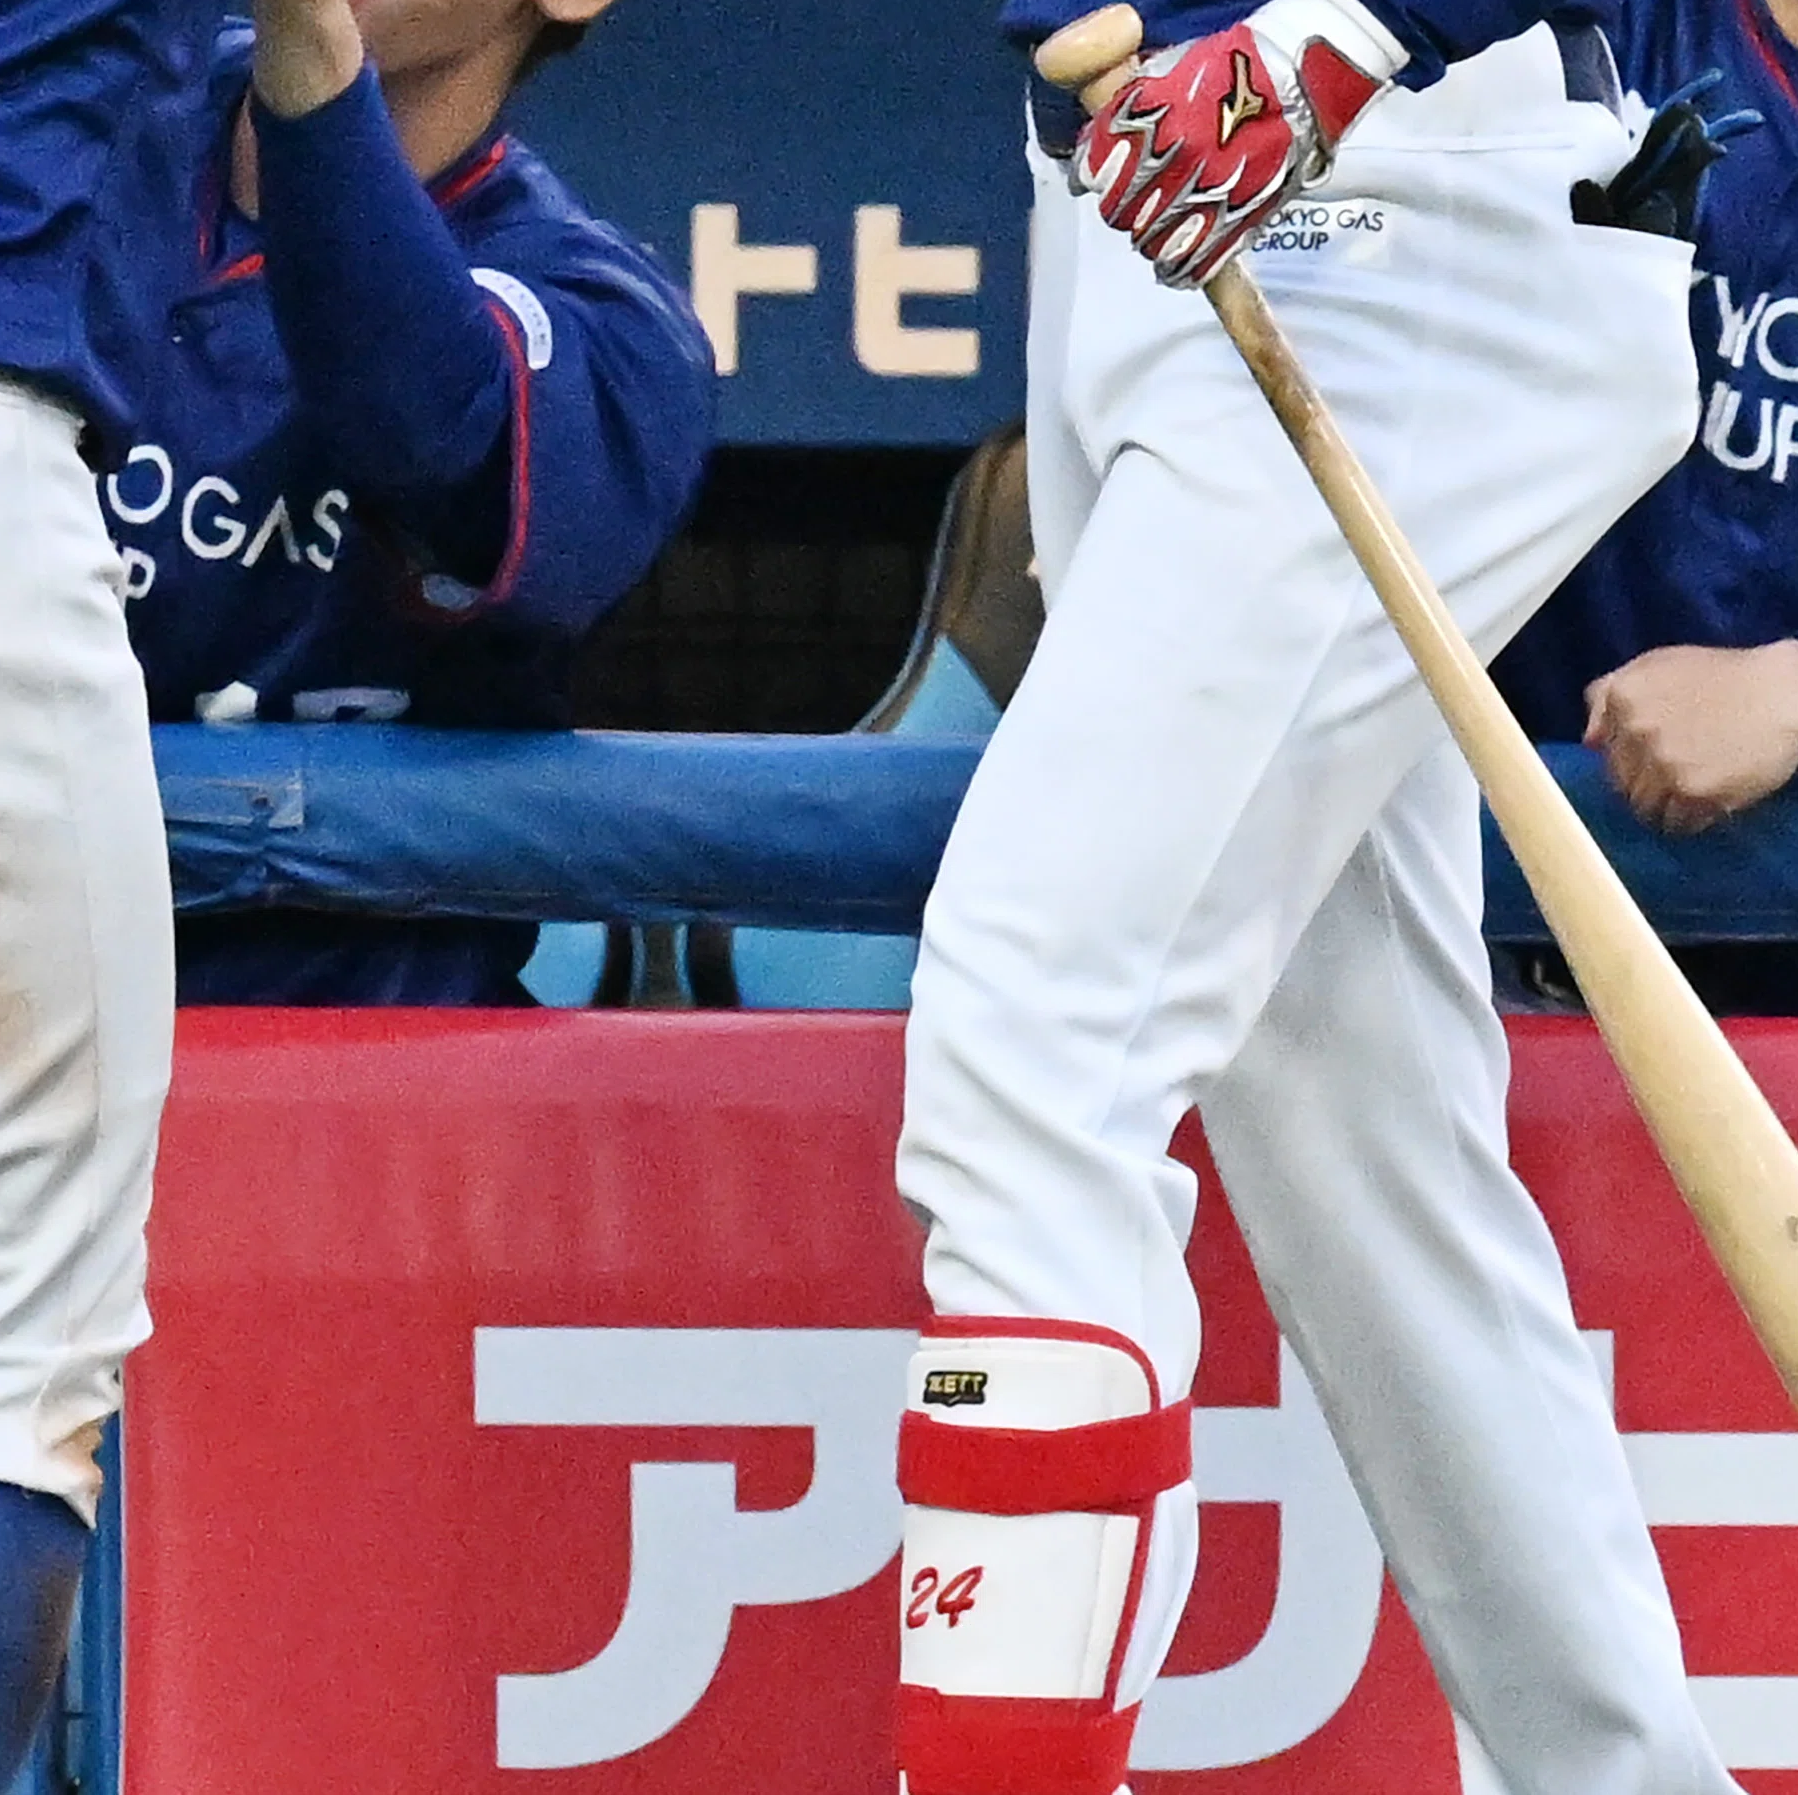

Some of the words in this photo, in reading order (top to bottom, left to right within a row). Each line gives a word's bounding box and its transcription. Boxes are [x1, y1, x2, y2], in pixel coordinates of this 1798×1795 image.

[1267, 207, 1330, 229] OKYO
[1336, 209, 1385, 232] GAS
[1252, 231, 1330, 253] GROUP
[180, 475, 350, 572] GAS
[927, 1374, 984, 1394] ZETT
[905, 1565, 985, 1630] 24
